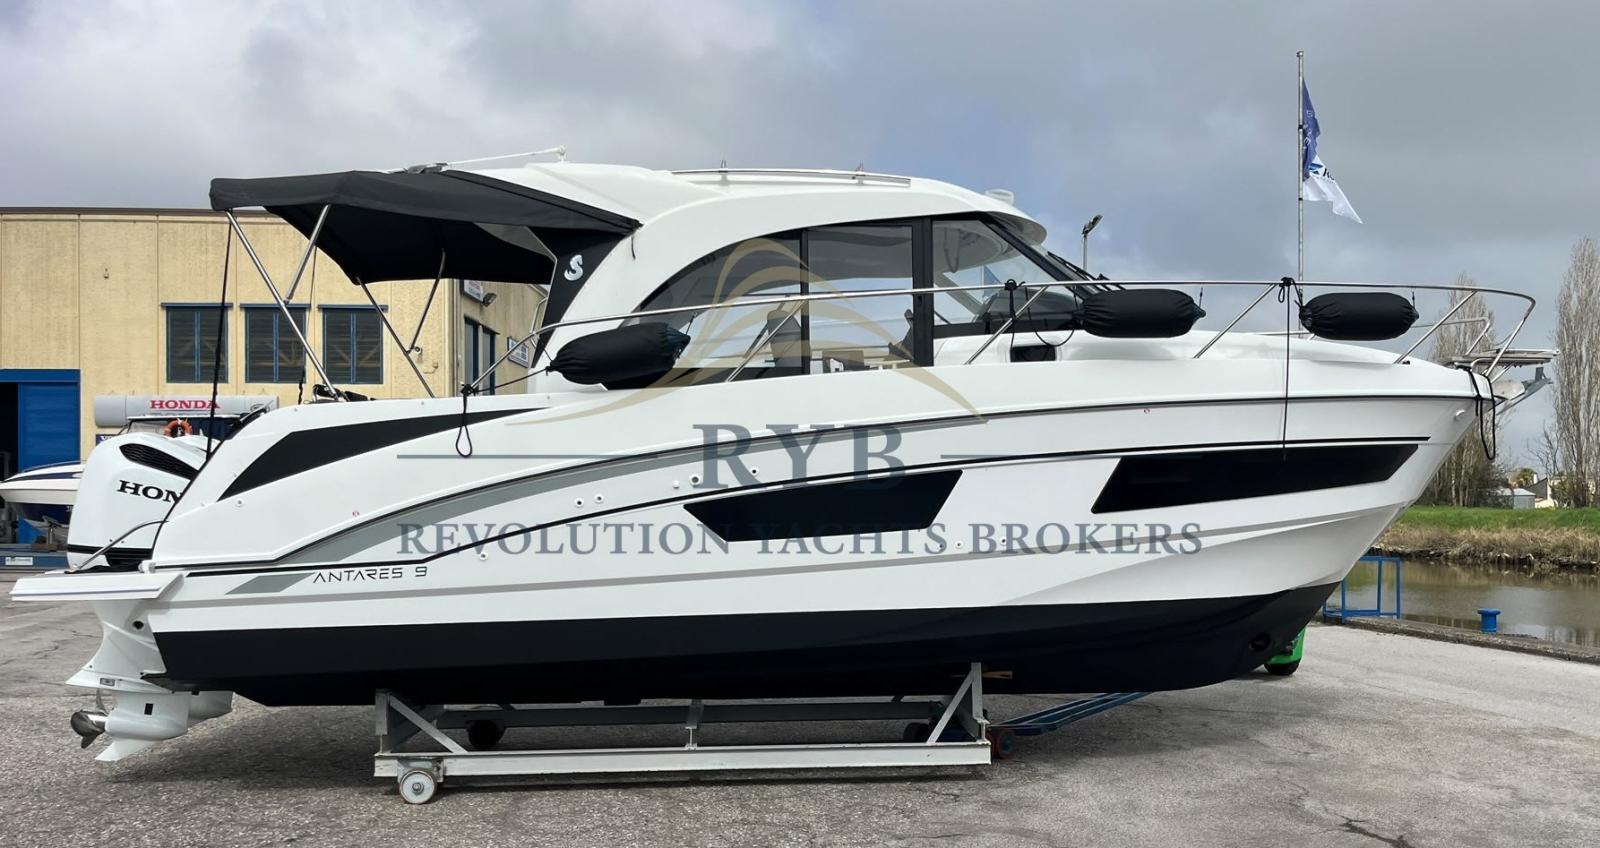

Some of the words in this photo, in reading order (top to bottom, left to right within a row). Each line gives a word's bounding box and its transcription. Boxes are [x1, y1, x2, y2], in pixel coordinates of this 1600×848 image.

[150, 400, 220, 409] HONDA
[117, 480, 182, 503] HON
[313, 568, 402, 583] ANTARES
[415, 566, 428, 577] 9
